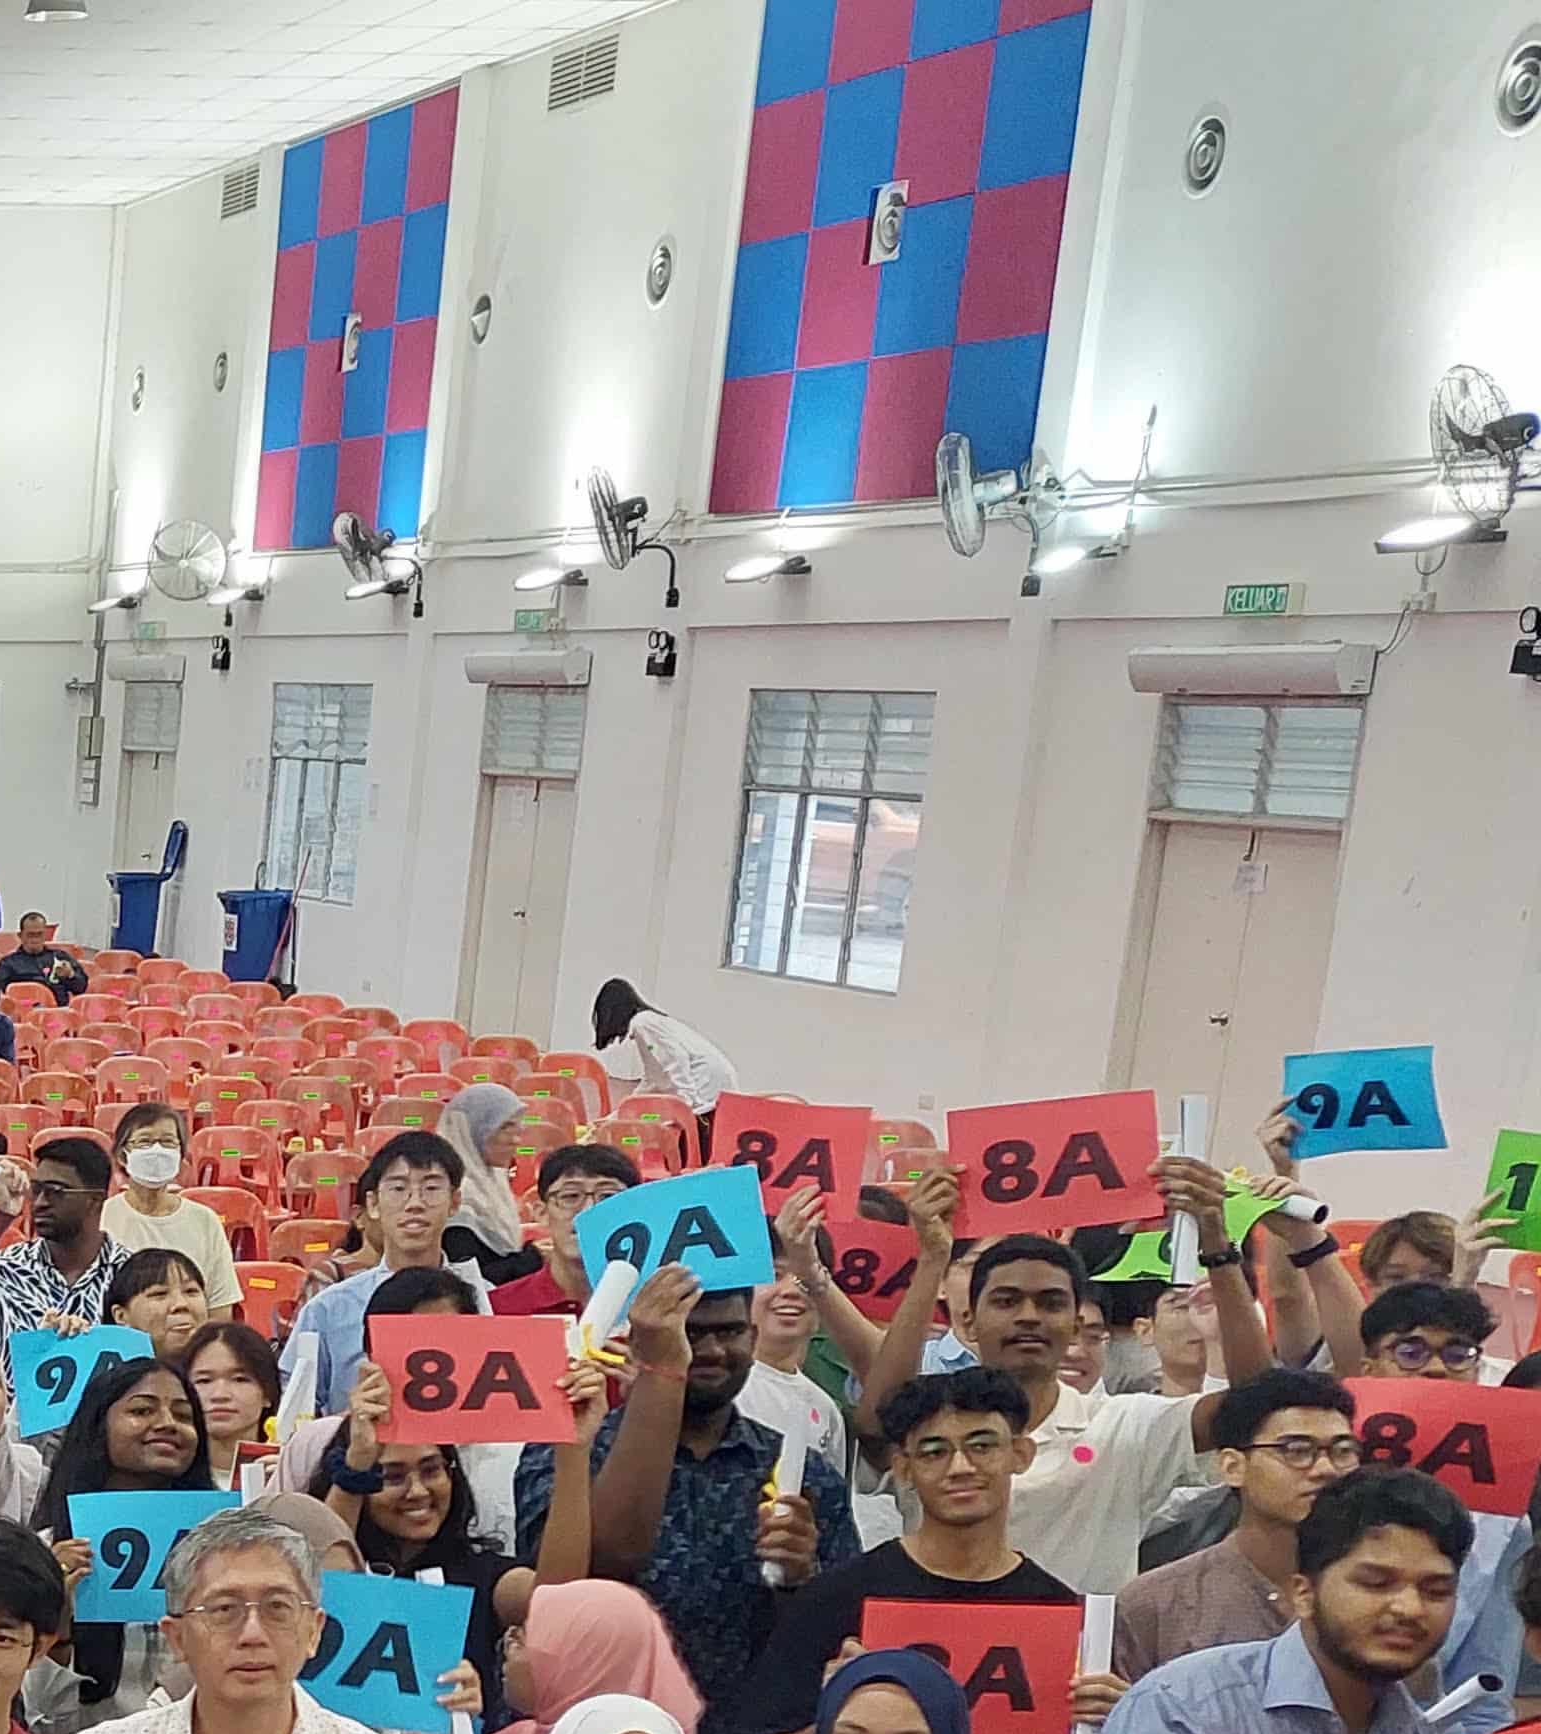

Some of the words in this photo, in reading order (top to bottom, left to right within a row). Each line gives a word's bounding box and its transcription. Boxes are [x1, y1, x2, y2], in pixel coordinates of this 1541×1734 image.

[1298, 1079, 1412, 1130] 9A
[980, 1131, 1126, 1204] 8A
[605, 1205, 740, 1272] 9A
[402, 1348, 542, 1413] 8A
[1361, 1411, 1496, 1485] 8A
[100, 1527, 191, 1590] 9
[904, 1642, 1035, 1713] A
